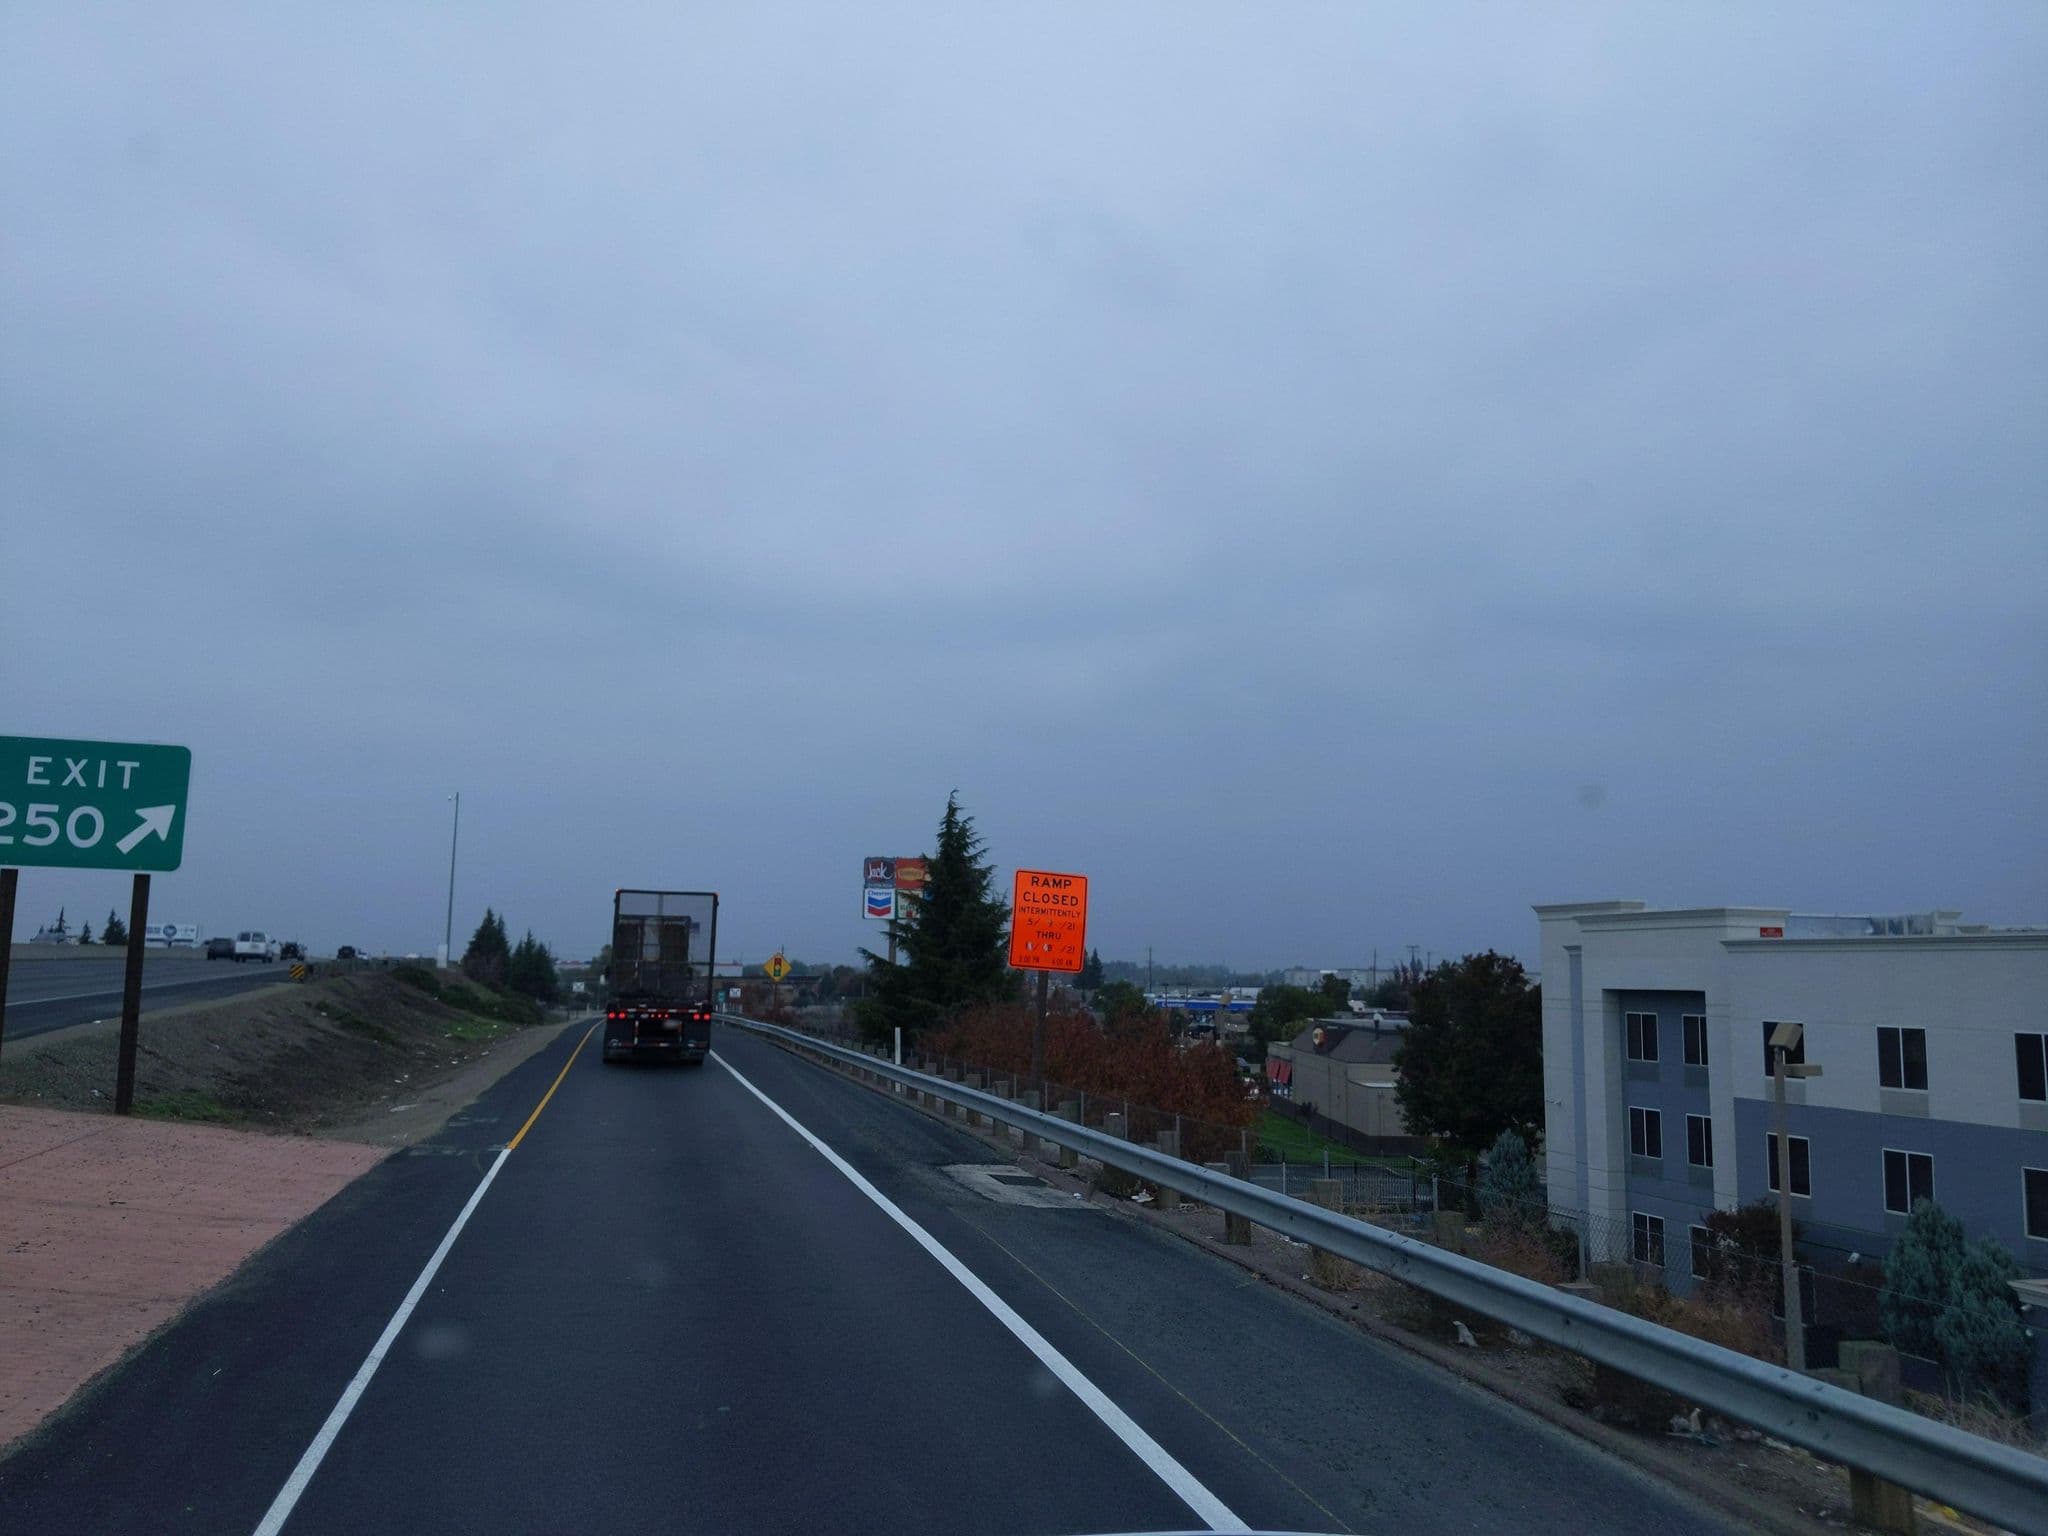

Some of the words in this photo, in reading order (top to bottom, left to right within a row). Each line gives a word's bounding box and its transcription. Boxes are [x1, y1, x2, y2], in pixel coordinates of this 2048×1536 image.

[27, 756, 140, 790] EXIT
[1031, 876, 1072, 889] RAMP
[1023, 891, 1079, 906] CLOSED
[1018, 905, 1081, 918] INTERMITTENTLY
[1036, 931, 1062, 940] THRU
